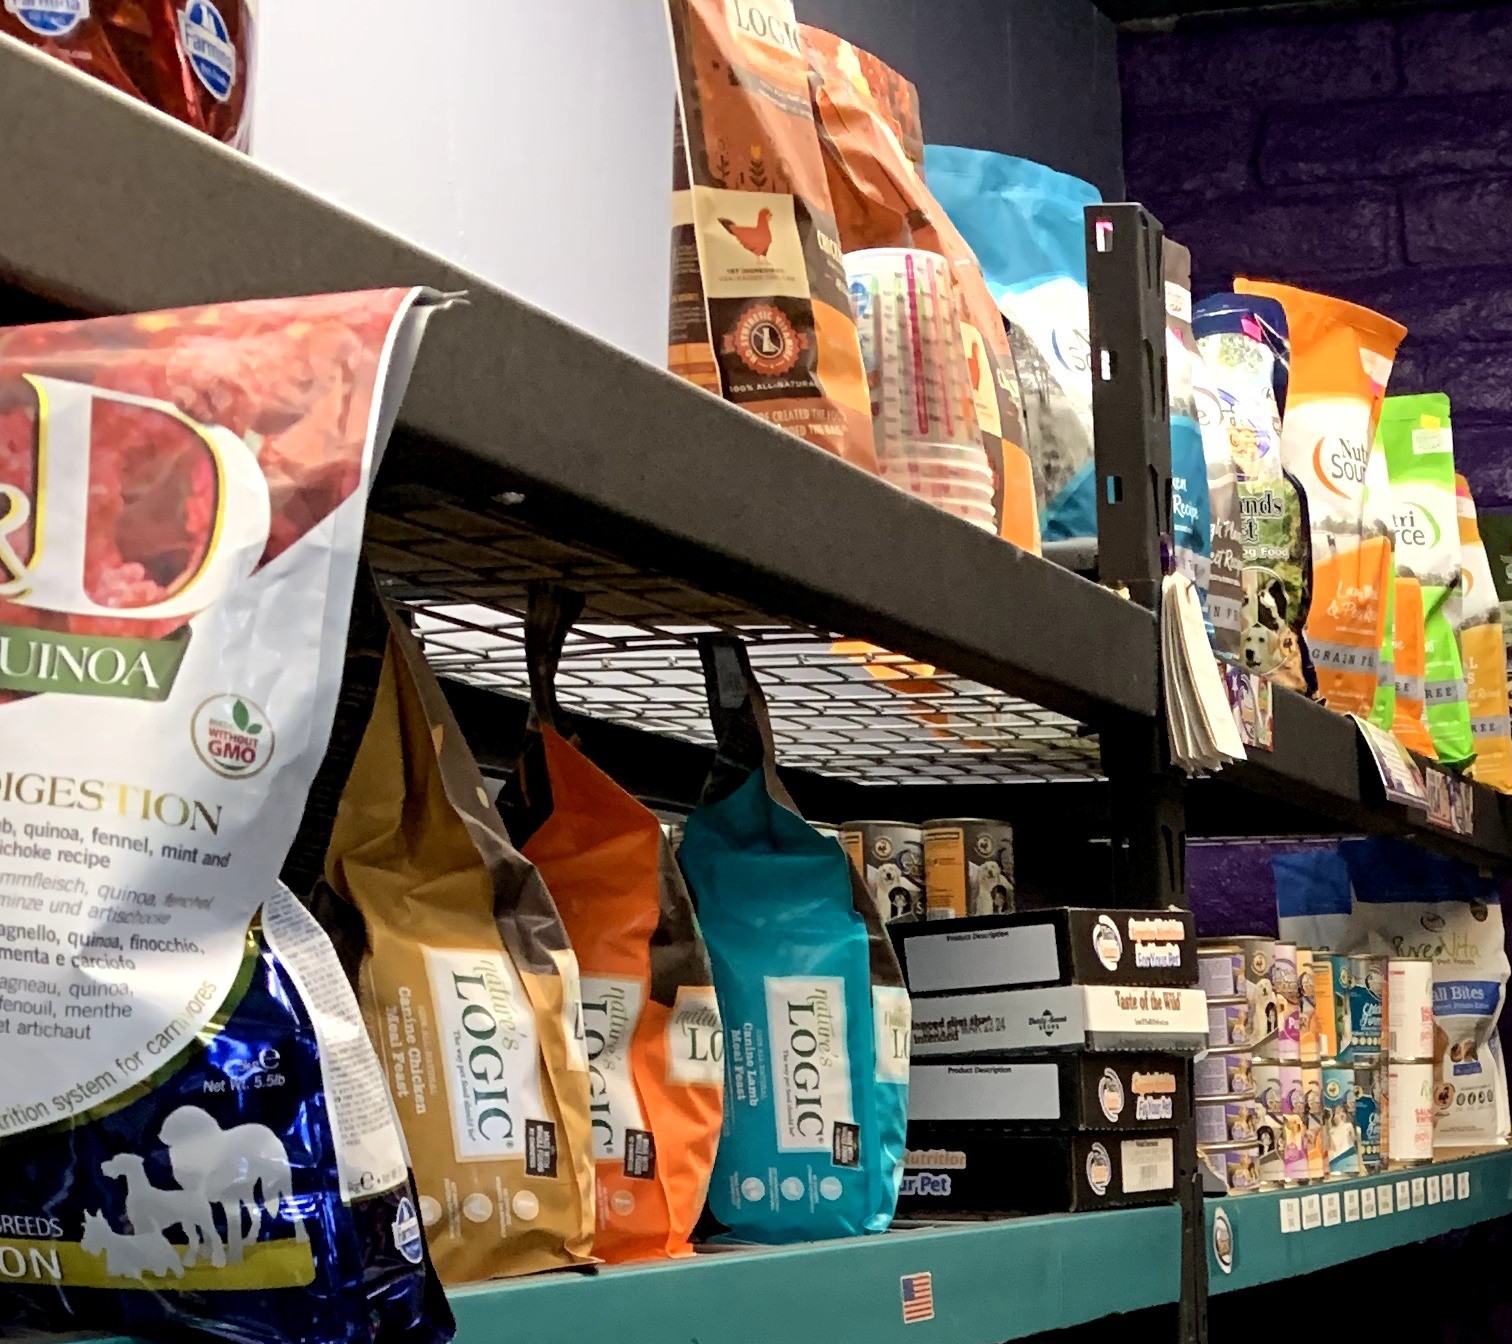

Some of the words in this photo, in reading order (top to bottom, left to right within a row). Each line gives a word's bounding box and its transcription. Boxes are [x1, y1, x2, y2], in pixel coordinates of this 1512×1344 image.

[1339, 438, 1368, 461] Nut
[0, 634, 160, 690] UINOA
[208, 740, 257, 765] GMO
[0, 772, 223, 836] IGESTION
[23, 821, 85, 845] quinoa,
[92, 828, 153, 856] fennel,
[161, 841, 199, 865] mint
[57, 849, 112, 870] recipe
[1451, 986, 1485, 1001] Bites
[64, 1001, 132, 1021] menthe
[16, 1021, 91, 1041] artichaut
[809, 987, 838, 1067] nature's
[52, 1067, 114, 1113] system
[115, 1045, 145, 1076] for
[145, 979, 217, 1056] carnivores
[452, 970, 514, 1142] LOGIC
[408, 1047, 427, 1116] Chicken
[788, 1001, 825, 1138] LOGIC
[203, 1078, 227, 1093] Net
[921, 1176, 949, 1193] Pet
[0, 1216, 63, 1239] REEDS
